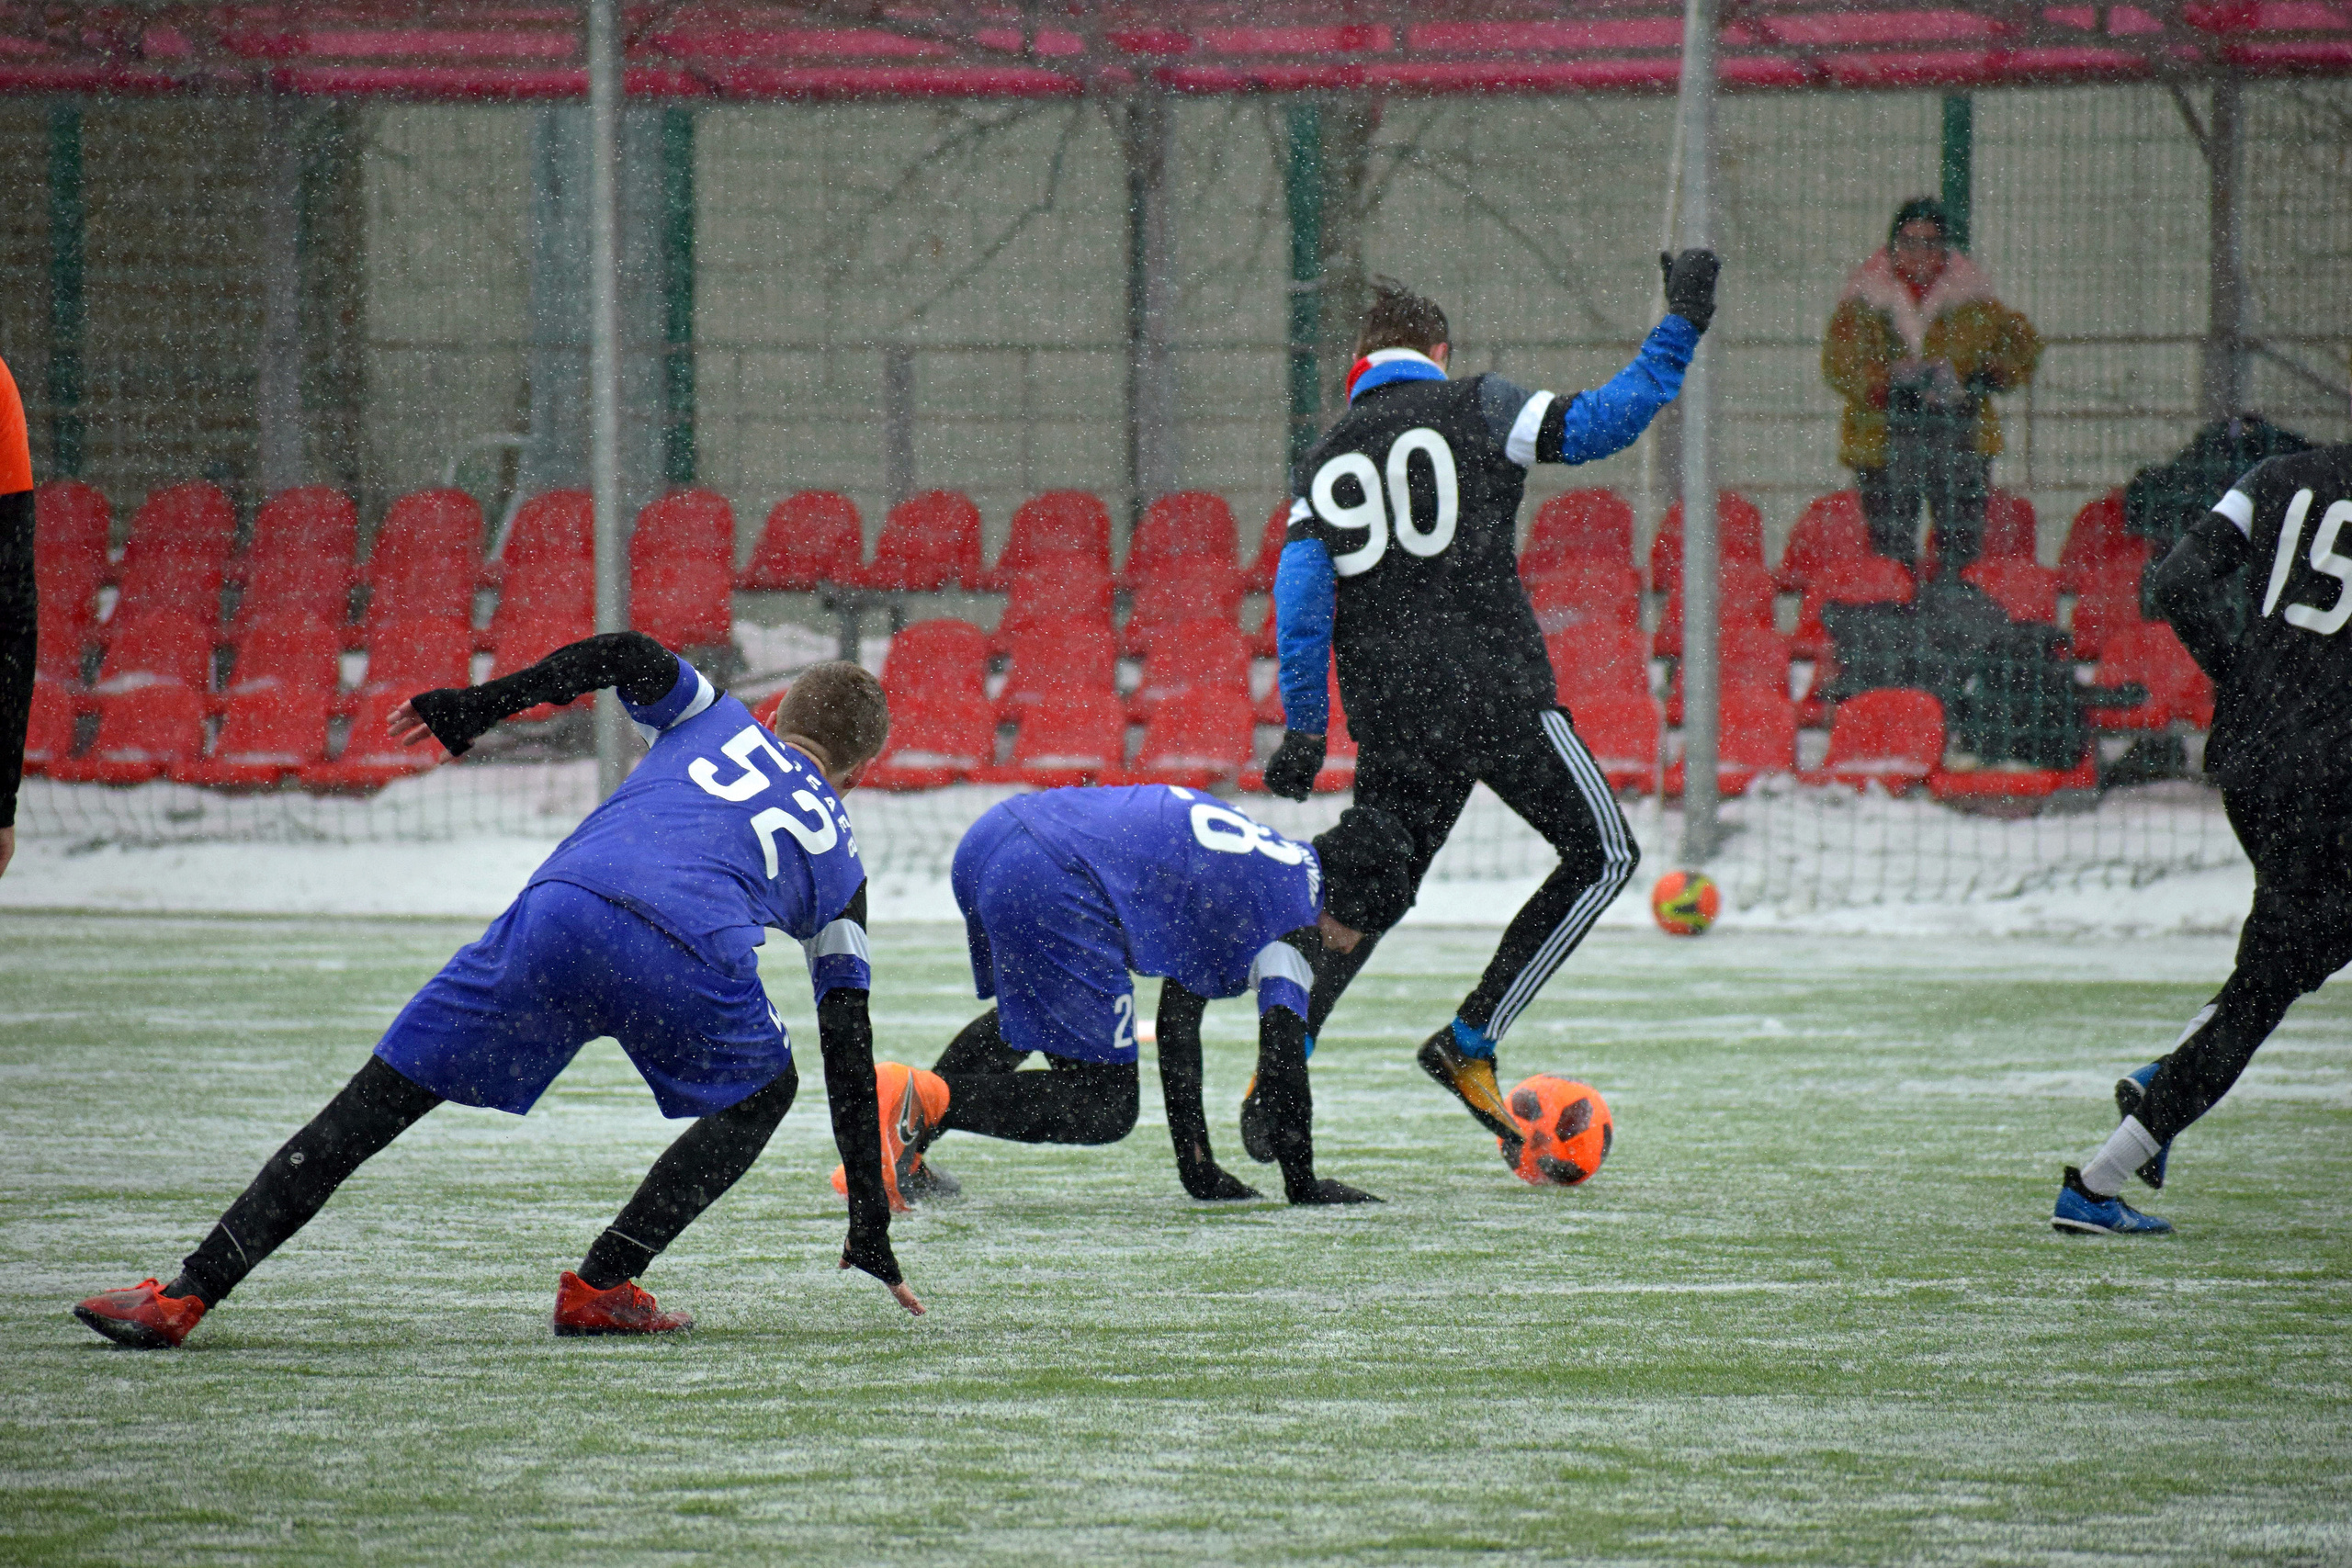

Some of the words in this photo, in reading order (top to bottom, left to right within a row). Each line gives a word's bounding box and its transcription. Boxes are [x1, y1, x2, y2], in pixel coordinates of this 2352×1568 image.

[1311, 426, 1459, 578] 90
[2261, 487, 2352, 636] 15
[687, 724, 838, 880] 52
[1168, 785, 1303, 865] 8
